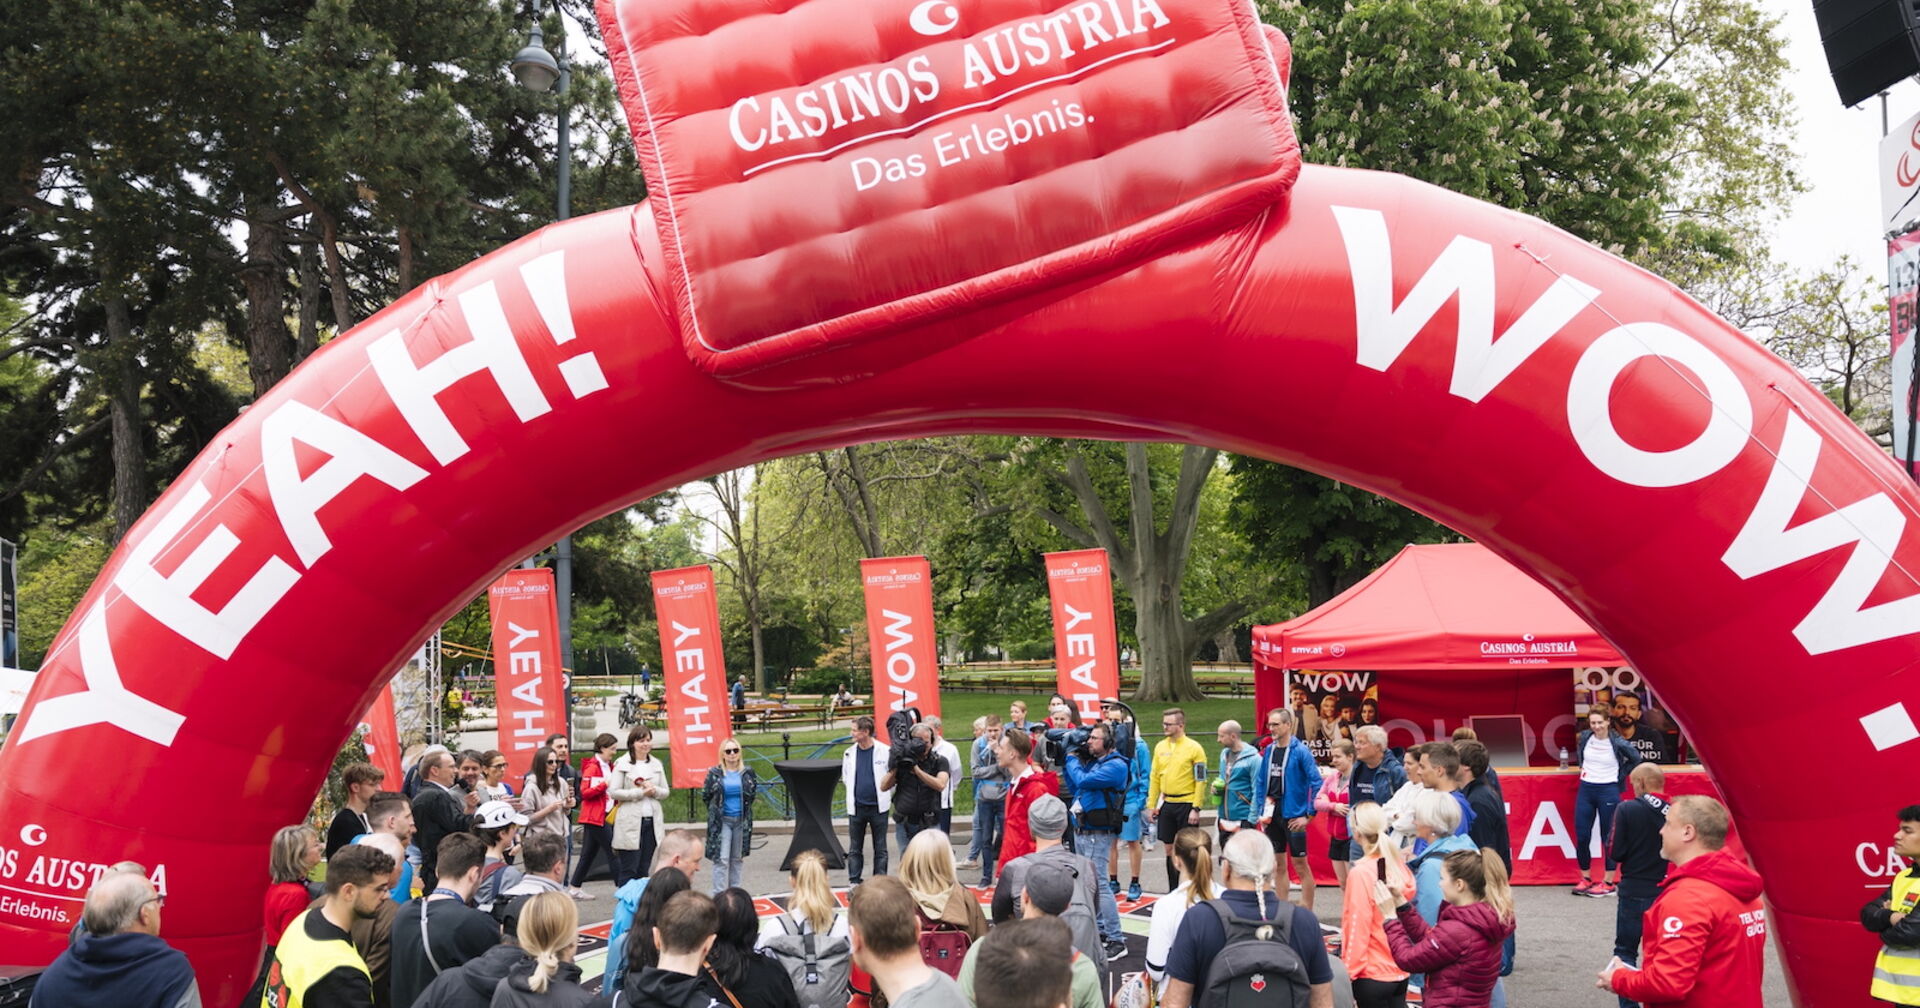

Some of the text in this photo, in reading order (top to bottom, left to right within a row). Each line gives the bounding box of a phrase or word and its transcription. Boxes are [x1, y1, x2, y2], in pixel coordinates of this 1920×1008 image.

[729, 0, 1171, 153] CASINOS AUSTRIA
[851, 98, 1096, 192] Das Erlebnis.
[16, 250, 609, 748] YEAH!
[1481, 640, 1577, 654] CASINOS AUSTRIA
[1294, 671, 1370, 693] WOW
[25, 855, 167, 897] AUSTA
[0, 896, 70, 923] Erlebnis.
